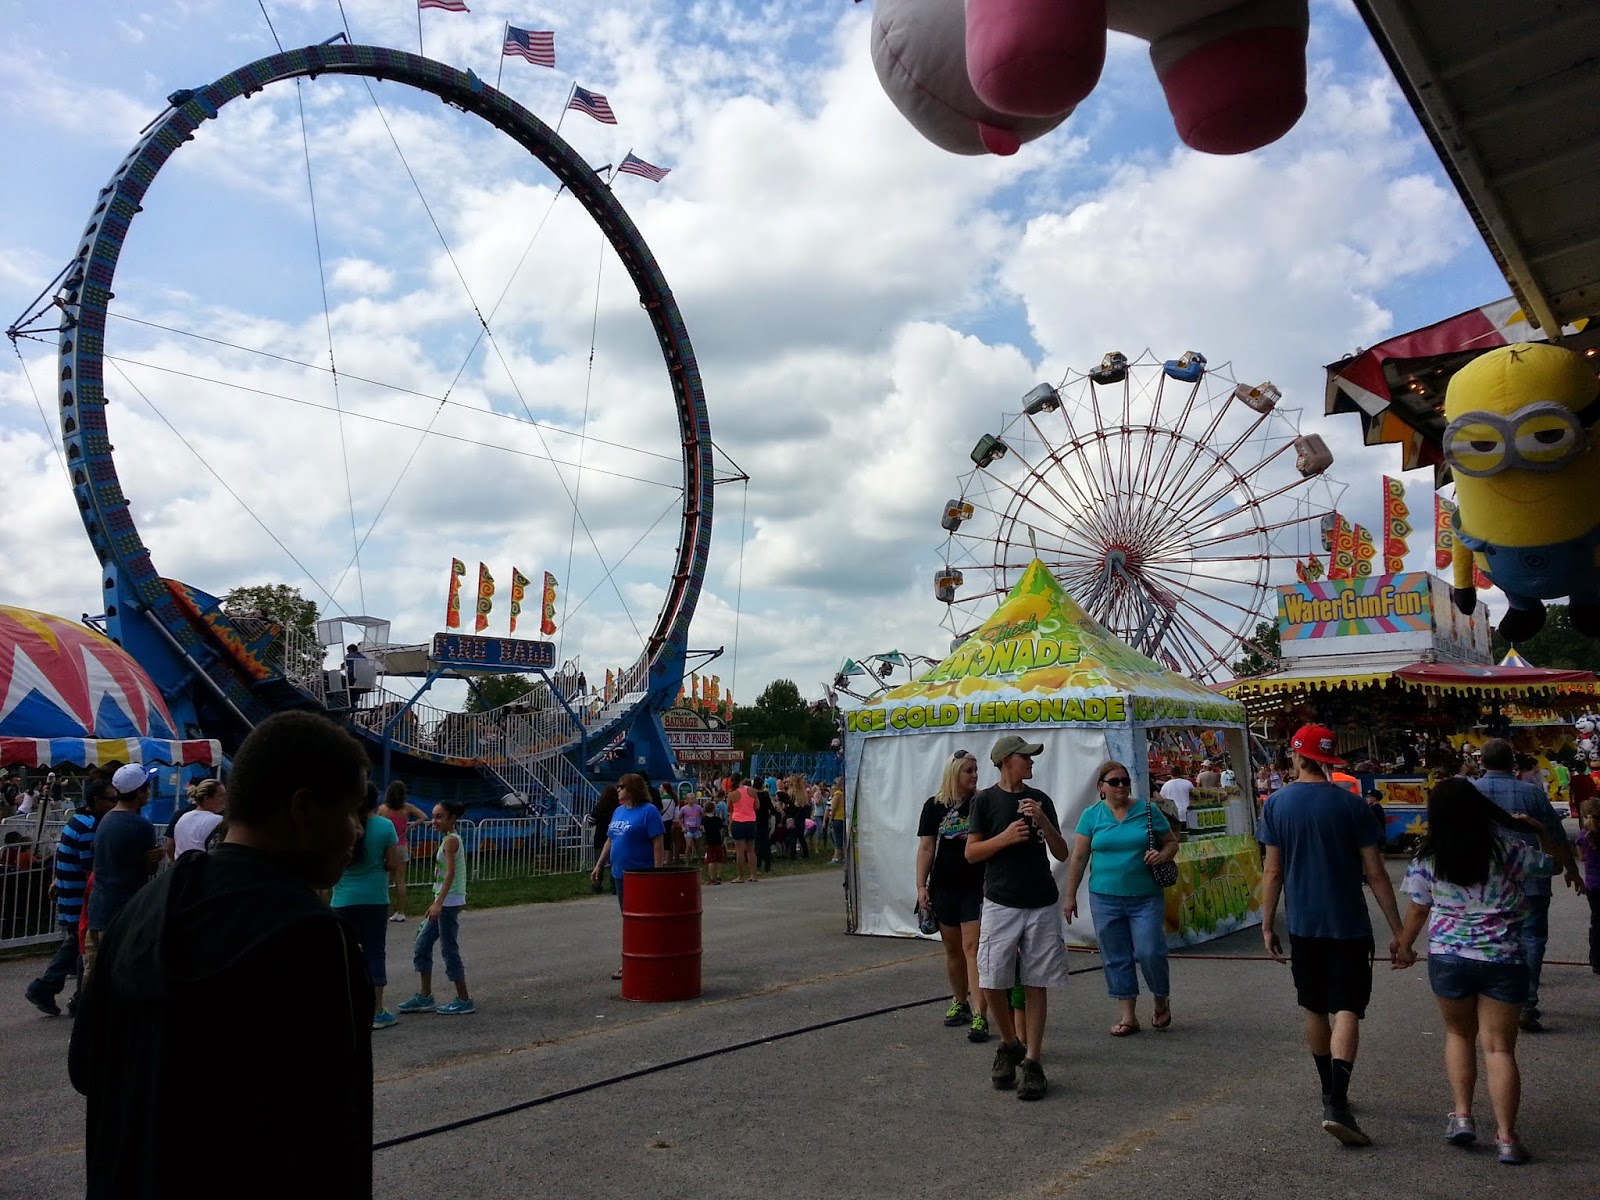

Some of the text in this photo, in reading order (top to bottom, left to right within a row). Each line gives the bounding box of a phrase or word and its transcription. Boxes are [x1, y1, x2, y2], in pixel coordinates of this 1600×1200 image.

[1284, 586, 1422, 625] WaterGunFun
[499, 640, 551, 664] BALL
[918, 639, 1083, 684] LEMONADE
[665, 716, 699, 727] SAUSAGE
[847, 697, 1127, 732] ICE COLD LEMONADE
[684, 733, 710, 744] FRENCH
[711, 733, 730, 744] FRIES
[680, 752, 694, 760] HOT
